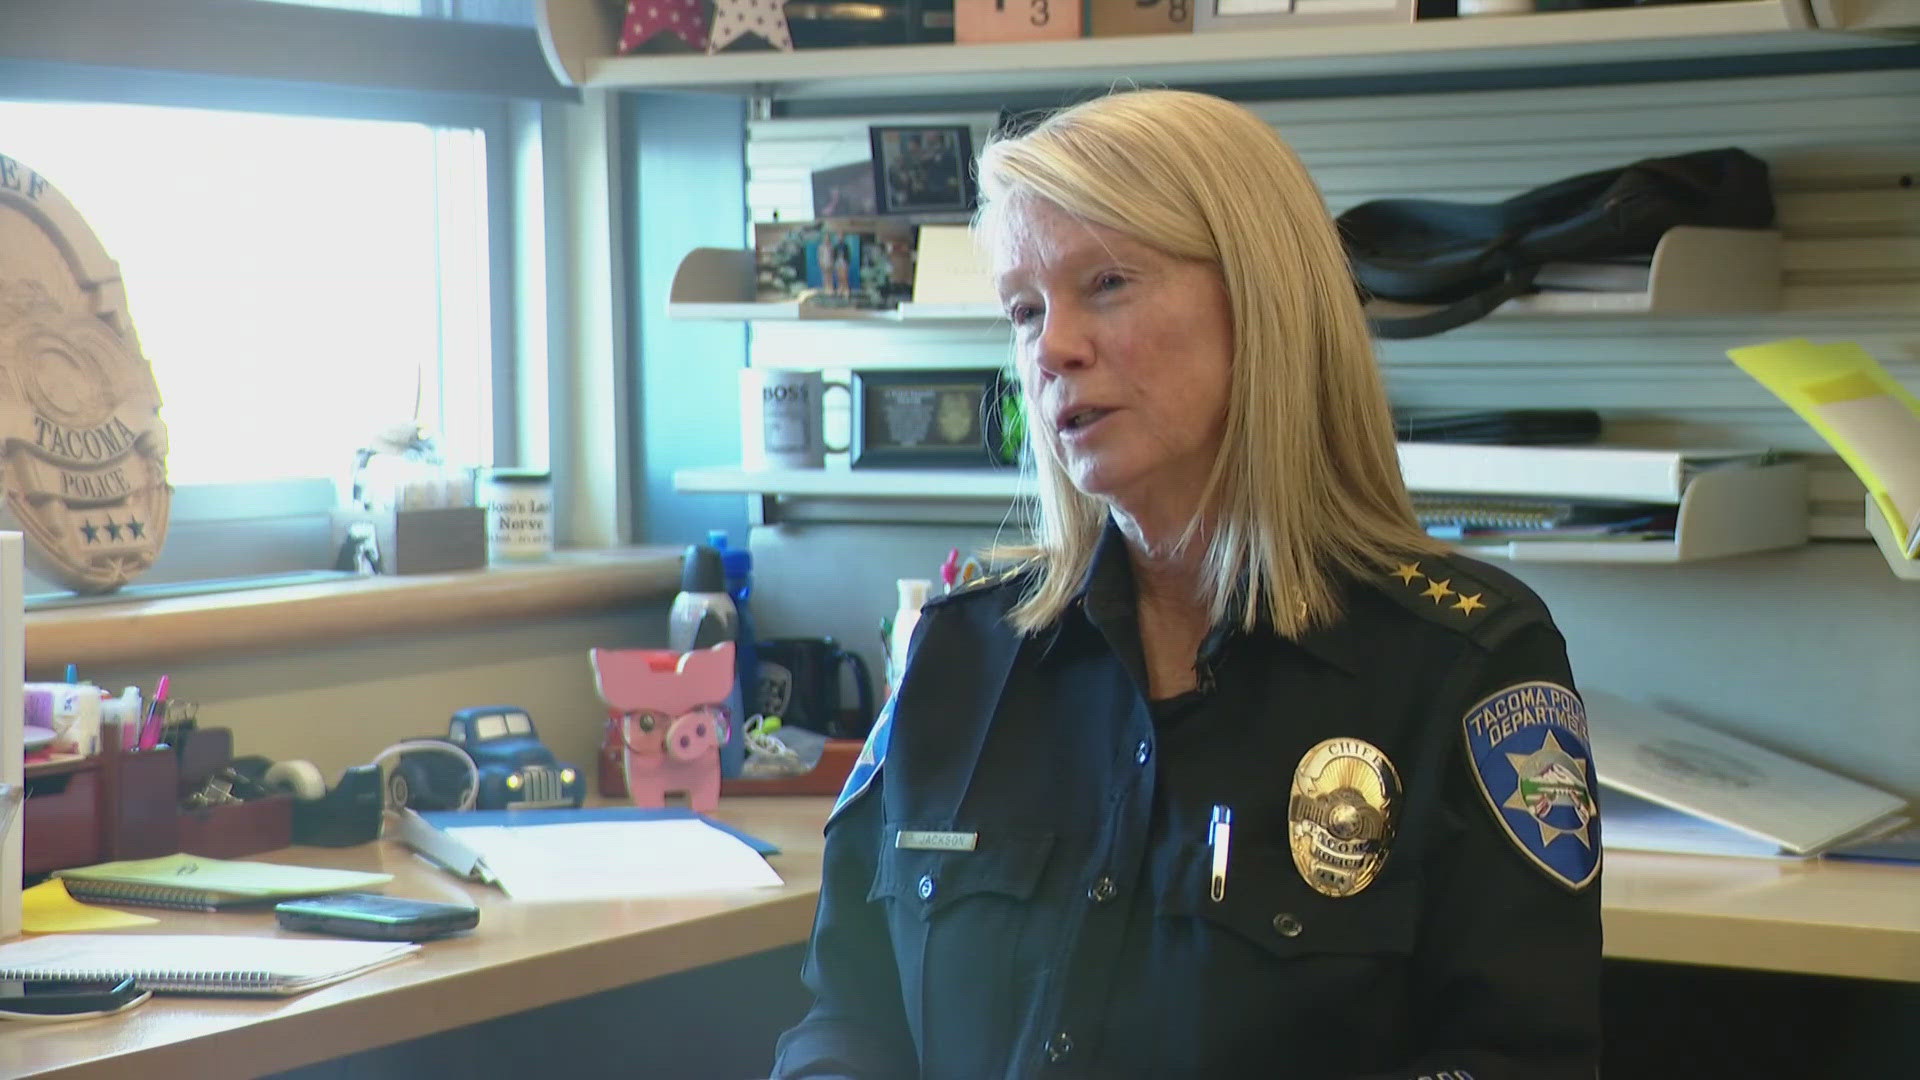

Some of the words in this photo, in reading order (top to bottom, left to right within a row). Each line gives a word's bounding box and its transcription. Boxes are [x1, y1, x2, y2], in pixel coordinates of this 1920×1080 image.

[0, 155, 49, 198] EF
[35, 416, 135, 460] TACOMA
[61, 467, 130, 497] POLICE
[1470, 687, 1548, 737] TACOMA
[921, 833, 967, 848] JACKSON
